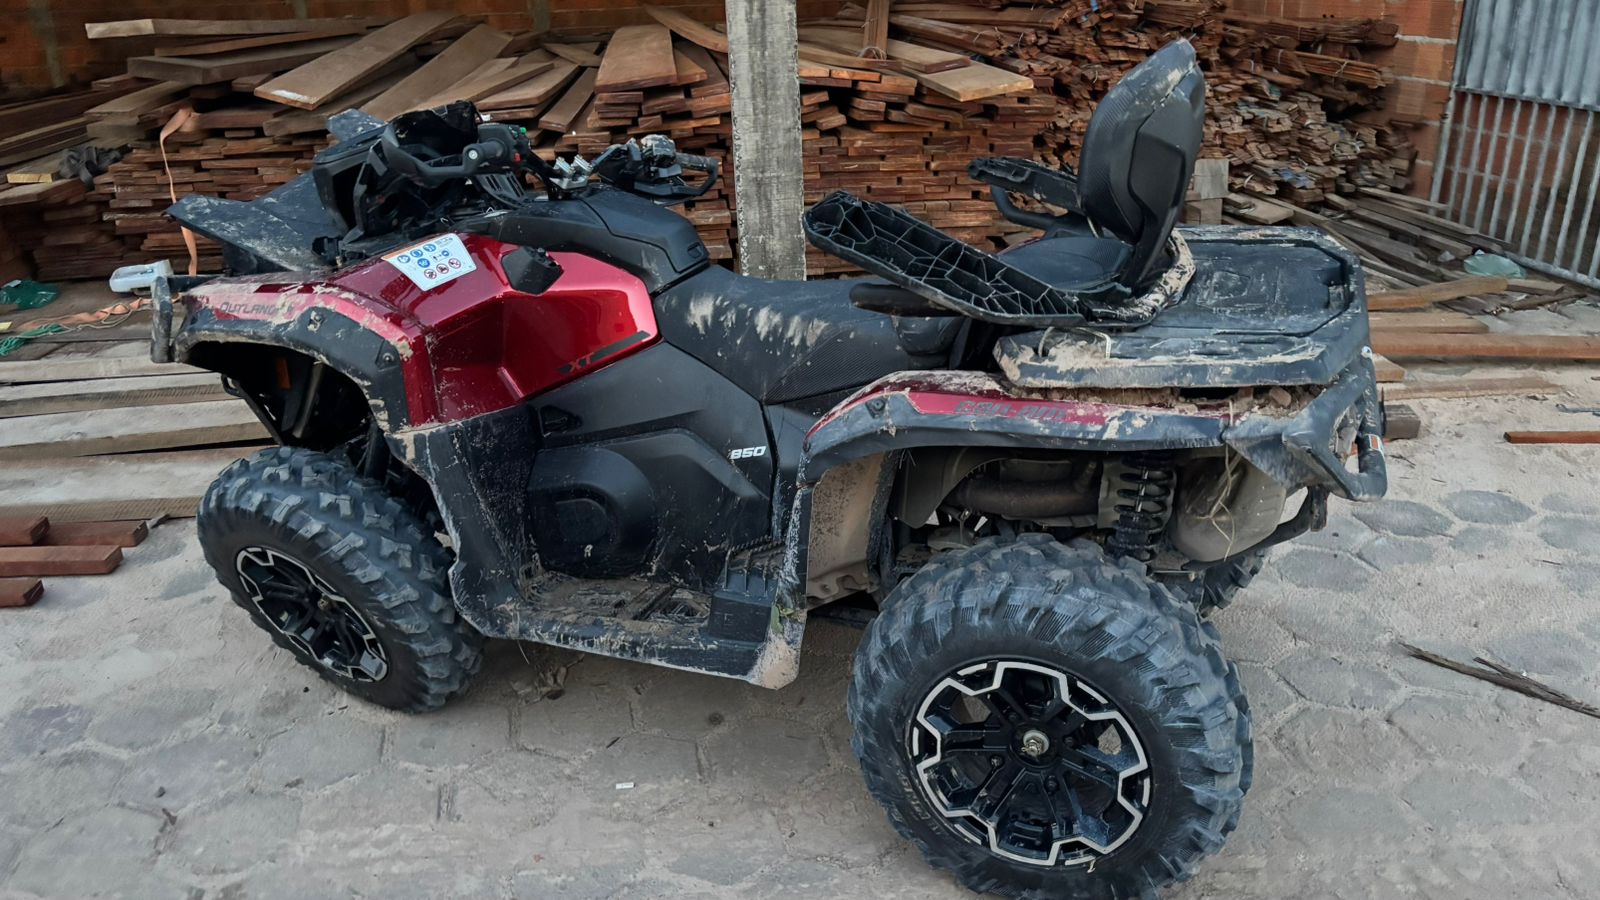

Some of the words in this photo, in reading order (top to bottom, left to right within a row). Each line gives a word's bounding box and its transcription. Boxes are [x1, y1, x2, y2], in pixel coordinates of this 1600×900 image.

[221, 301, 295, 315] OUTLANDR
[567, 352, 595, 373] XT
[730, 446, 767, 460] 850
